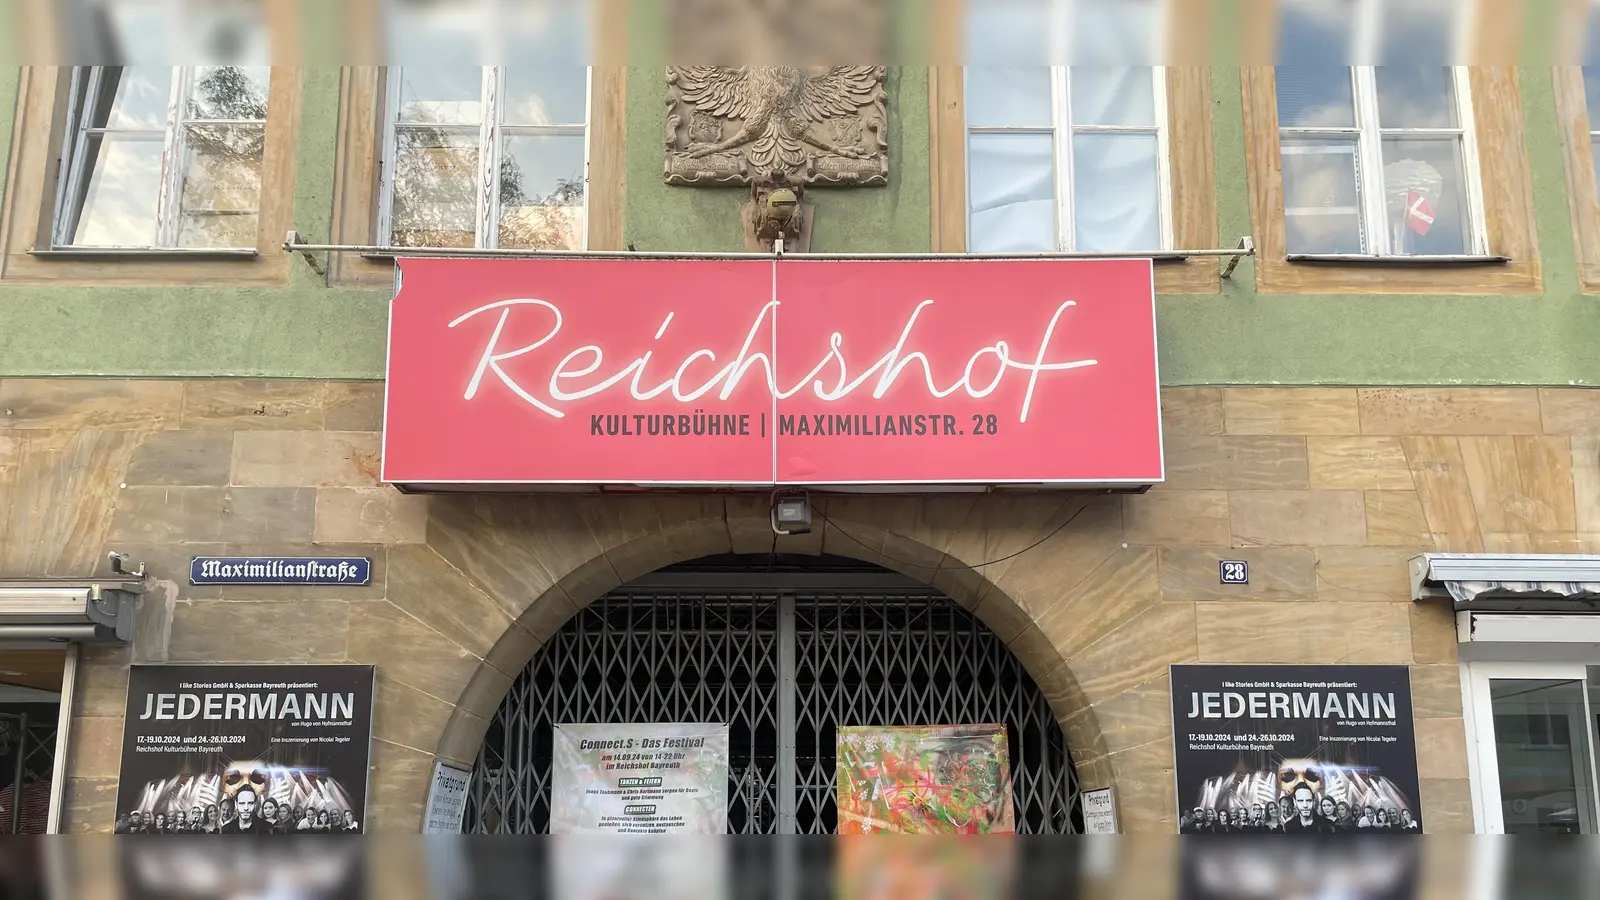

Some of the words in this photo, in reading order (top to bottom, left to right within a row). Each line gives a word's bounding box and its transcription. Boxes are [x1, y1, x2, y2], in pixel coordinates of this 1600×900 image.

[448, 298, 1098, 422] Reichshof
[591, 410, 750, 436] KULTURBÜHNE
[779, 413, 964, 436] MAXIMILIANSTR.
[972, 413, 998, 436] 28
[1225, 563, 1244, 580] 28
[139, 693, 354, 719] JEDERMANN
[1188, 692, 1396, 718] JEDERMANN
[580, 738, 633, 749] Connect.S
[641, 738, 661, 748] Das
[663, 737, 704, 748] Festival
[616, 762, 649, 770] Reichshof
[650, 762, 680, 770] Bayreuth
